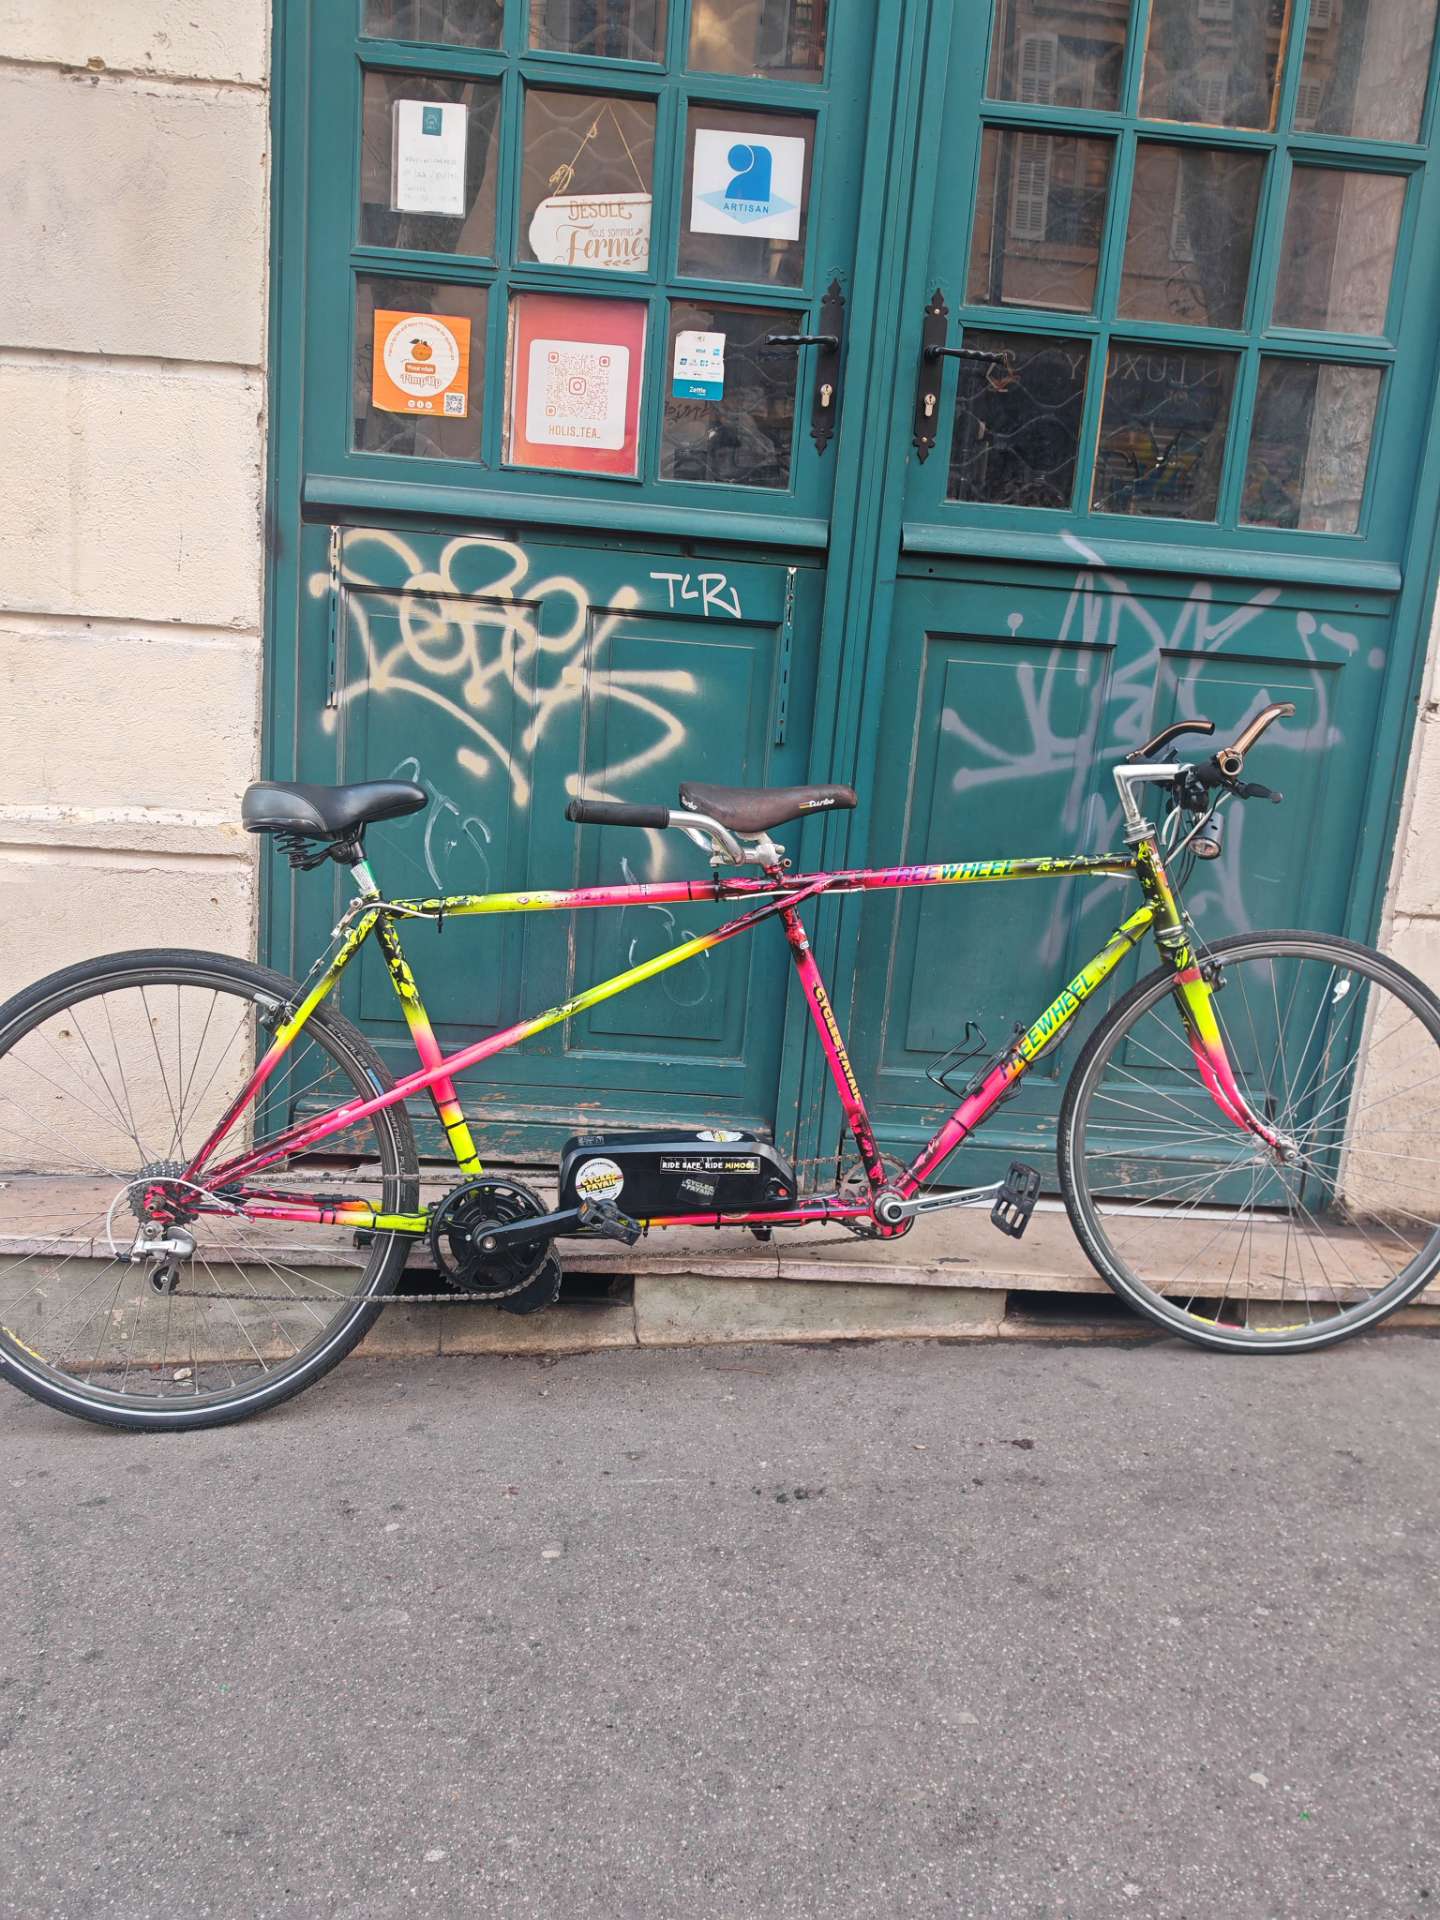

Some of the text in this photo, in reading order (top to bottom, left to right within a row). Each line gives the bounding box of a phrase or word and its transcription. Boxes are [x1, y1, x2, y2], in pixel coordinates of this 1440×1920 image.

[722, 202, 769, 214] ARTISAN
[808, 798, 835, 808] Turbo
[882, 860, 1014, 883] FREEWHEEL
[662, 1161, 680, 1169] RIDE
